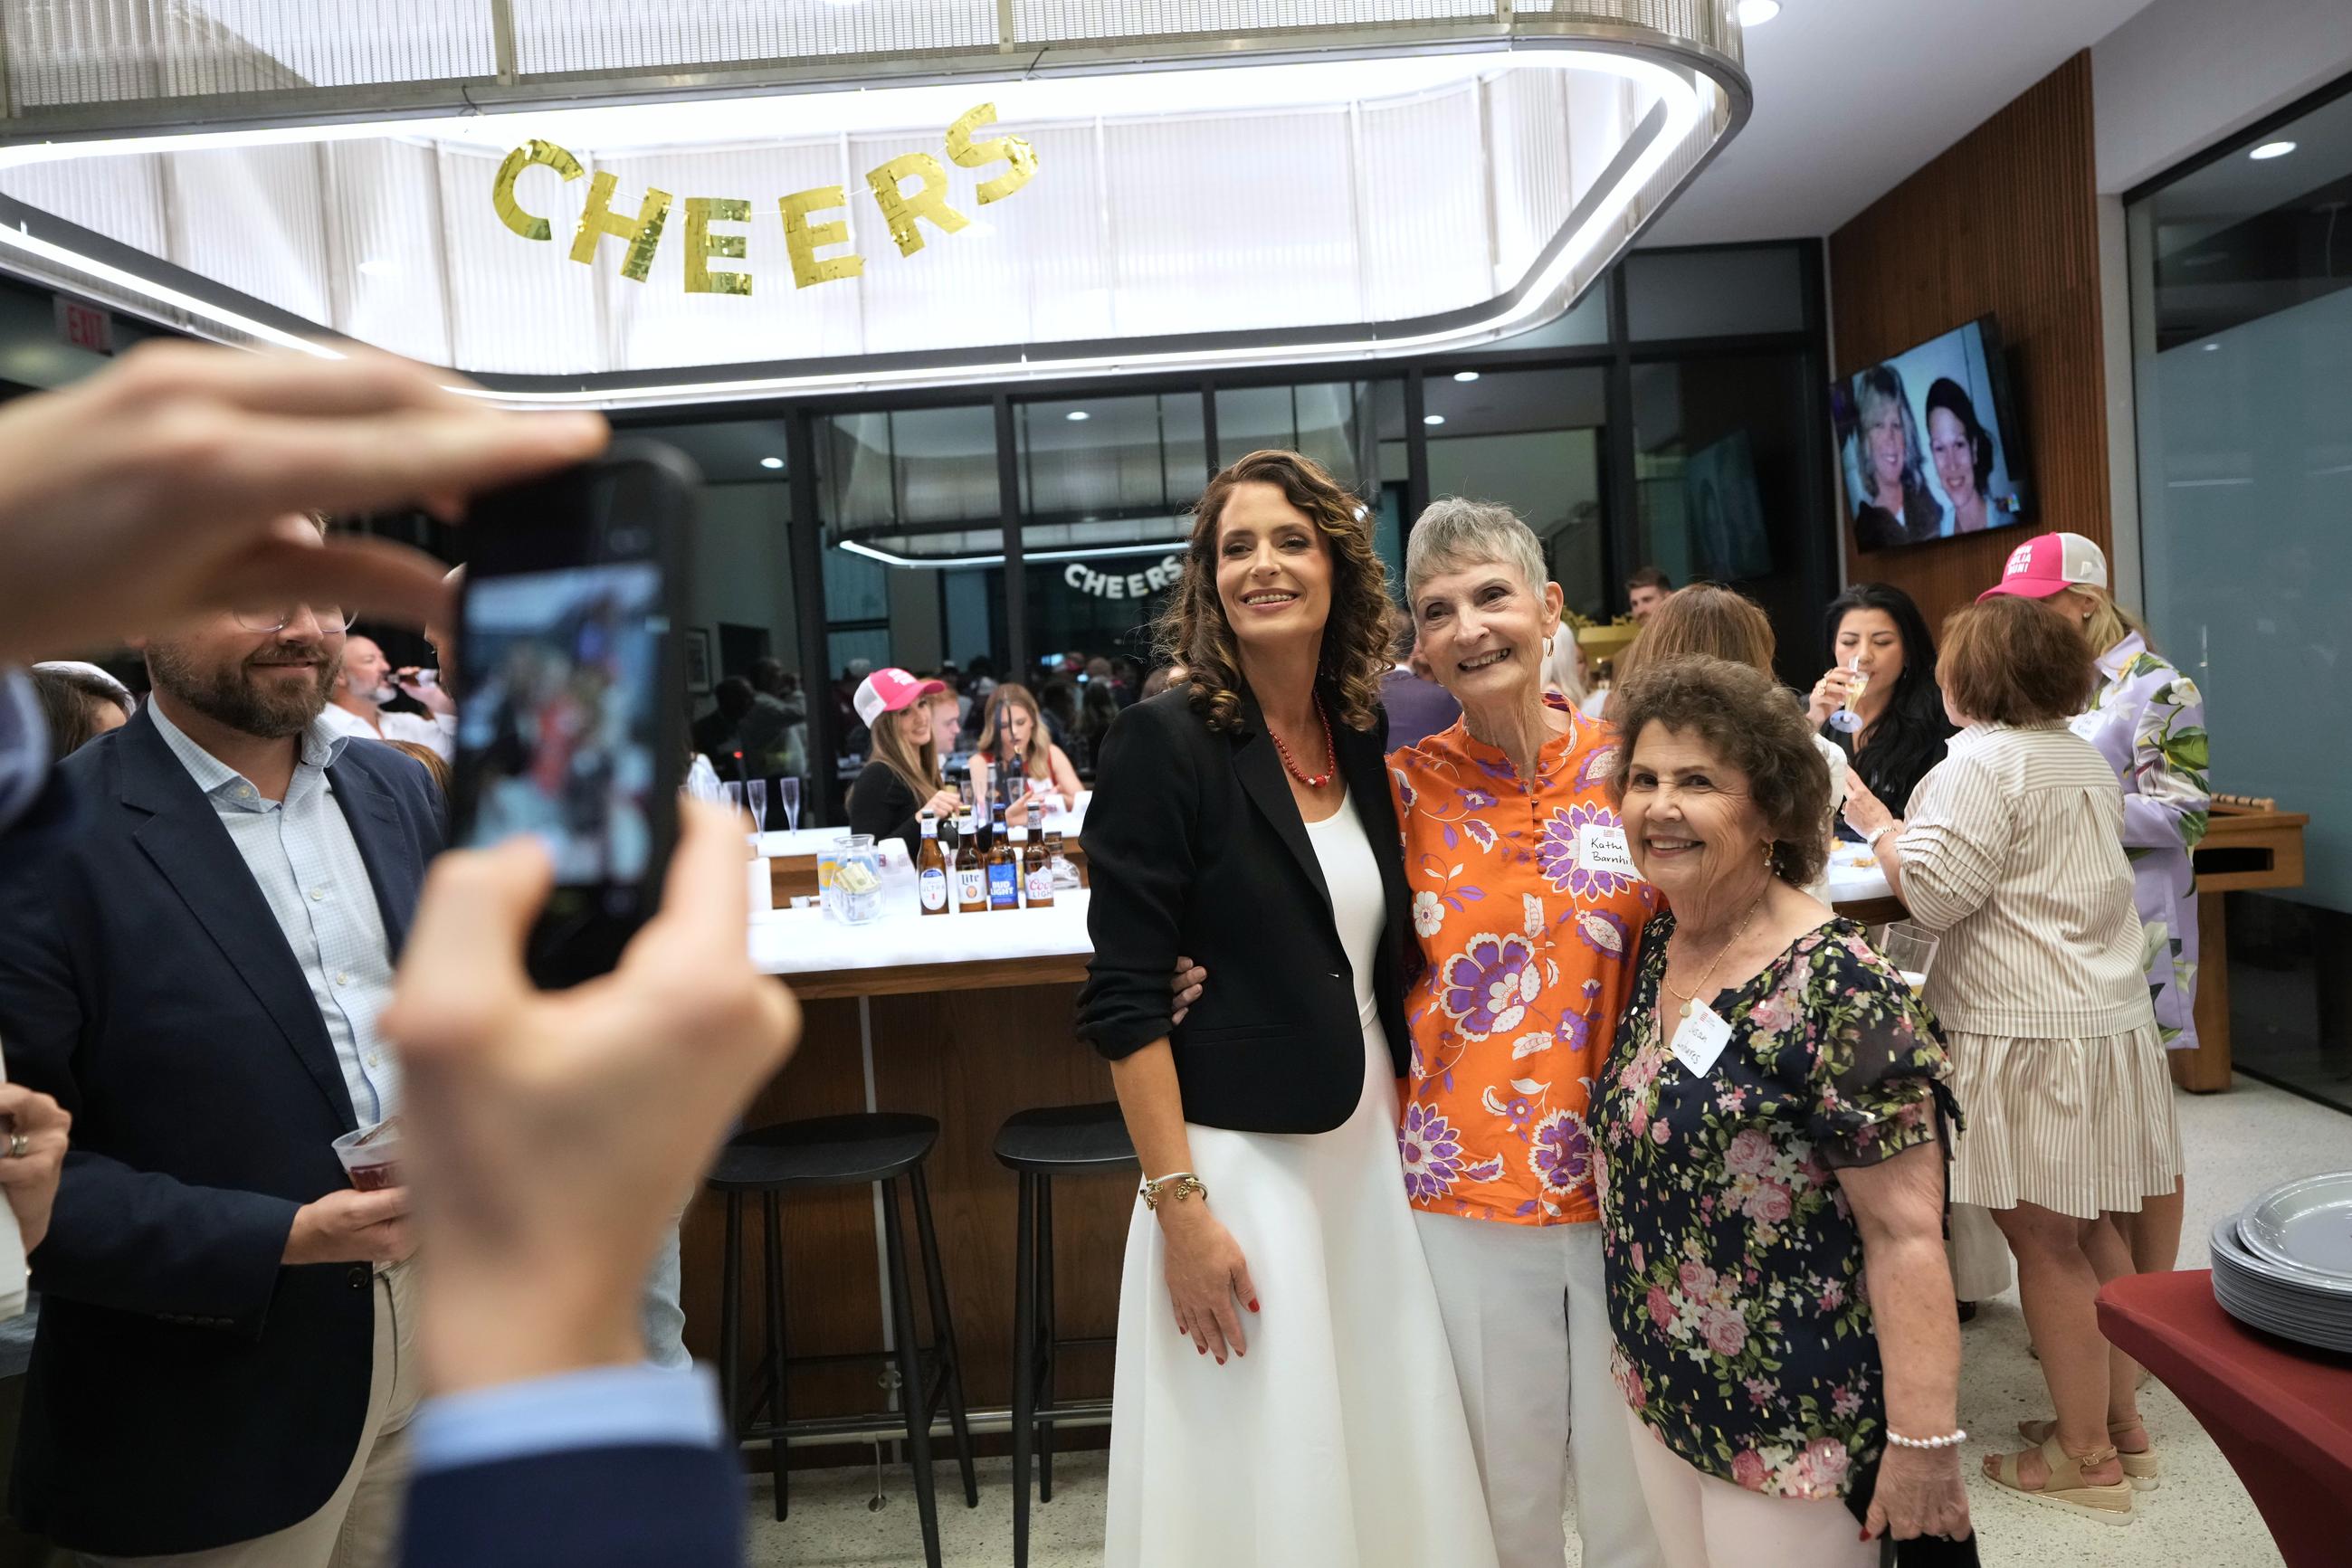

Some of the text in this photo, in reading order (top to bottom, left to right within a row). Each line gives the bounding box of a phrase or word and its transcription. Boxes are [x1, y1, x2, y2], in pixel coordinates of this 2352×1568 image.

[492, 101, 1039, 296] CHEERS
[1064, 555, 1184, 599] CHEERS
[1591, 851, 1637, 868] Barnhil
[961, 873, 980, 886] Lite
[992, 880, 1011, 889] BUD
[990, 887, 1014, 896] LIGHT
[1033, 889, 1052, 898] LIGH
